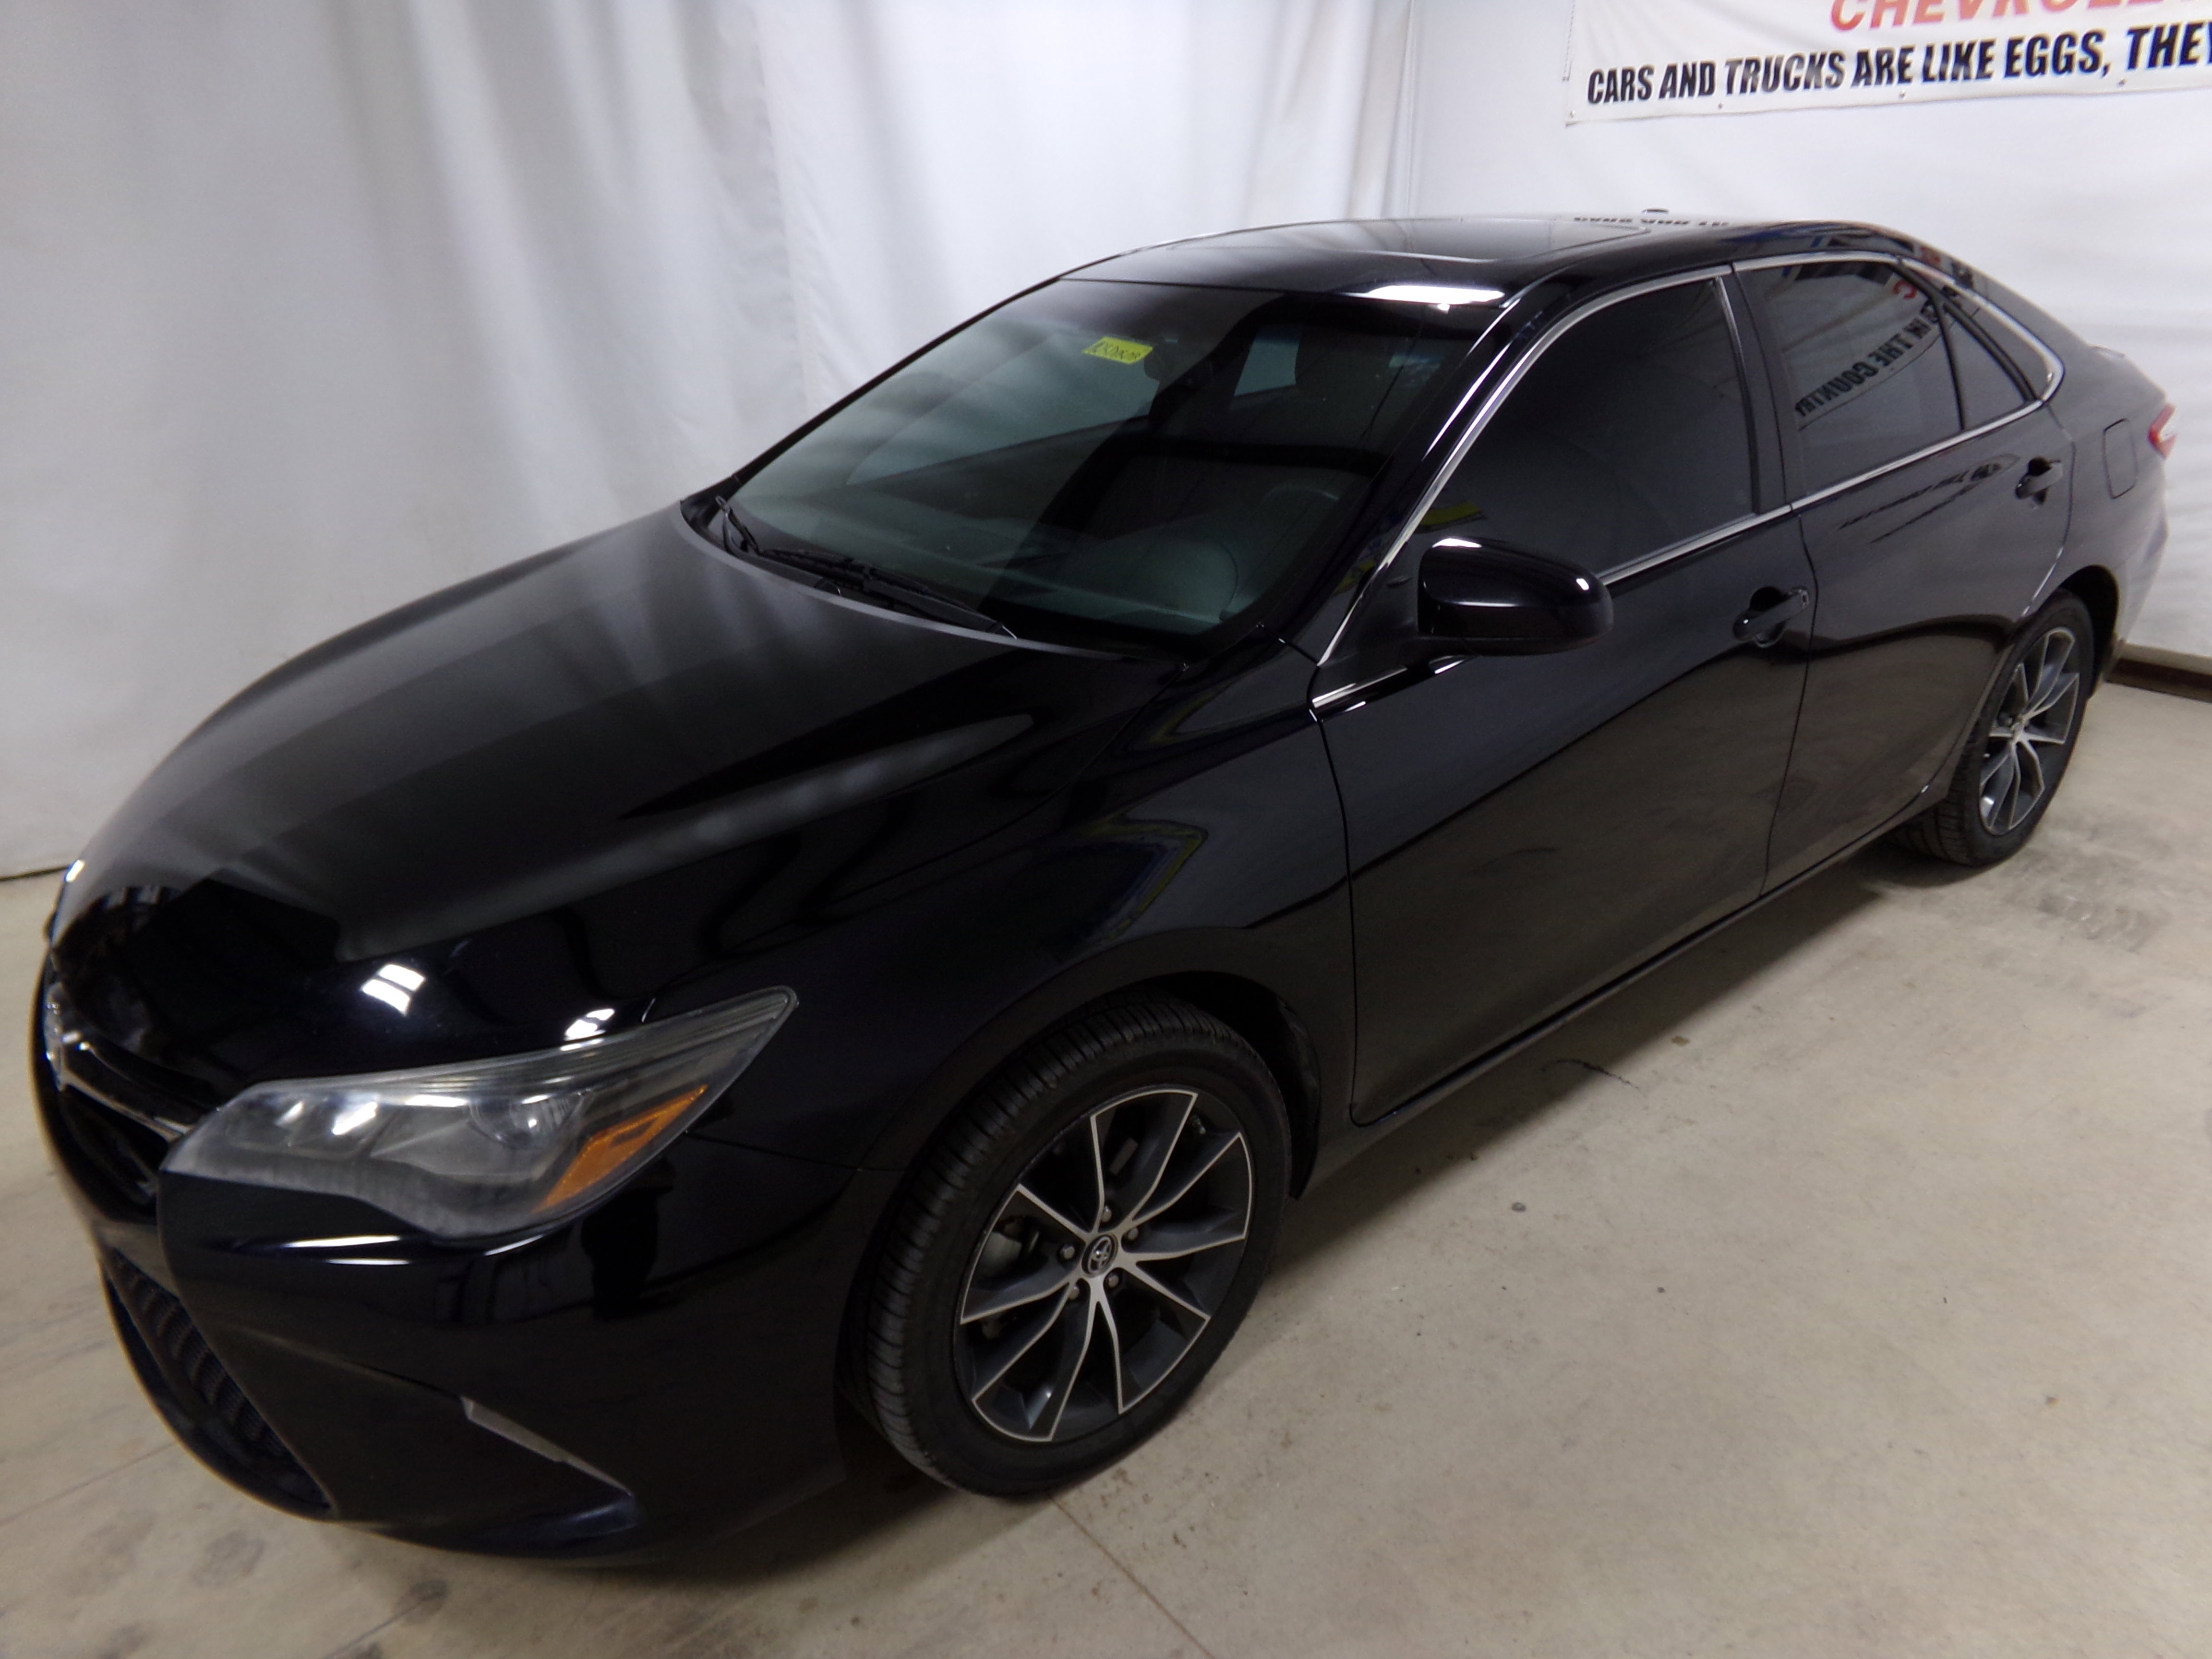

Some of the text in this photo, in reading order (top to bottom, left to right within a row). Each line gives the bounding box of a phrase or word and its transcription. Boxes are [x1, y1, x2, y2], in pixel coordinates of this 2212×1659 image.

[1587, 20, 2212, 104] CARS AND TRUCKS ARE LIKE EGGS, THE
